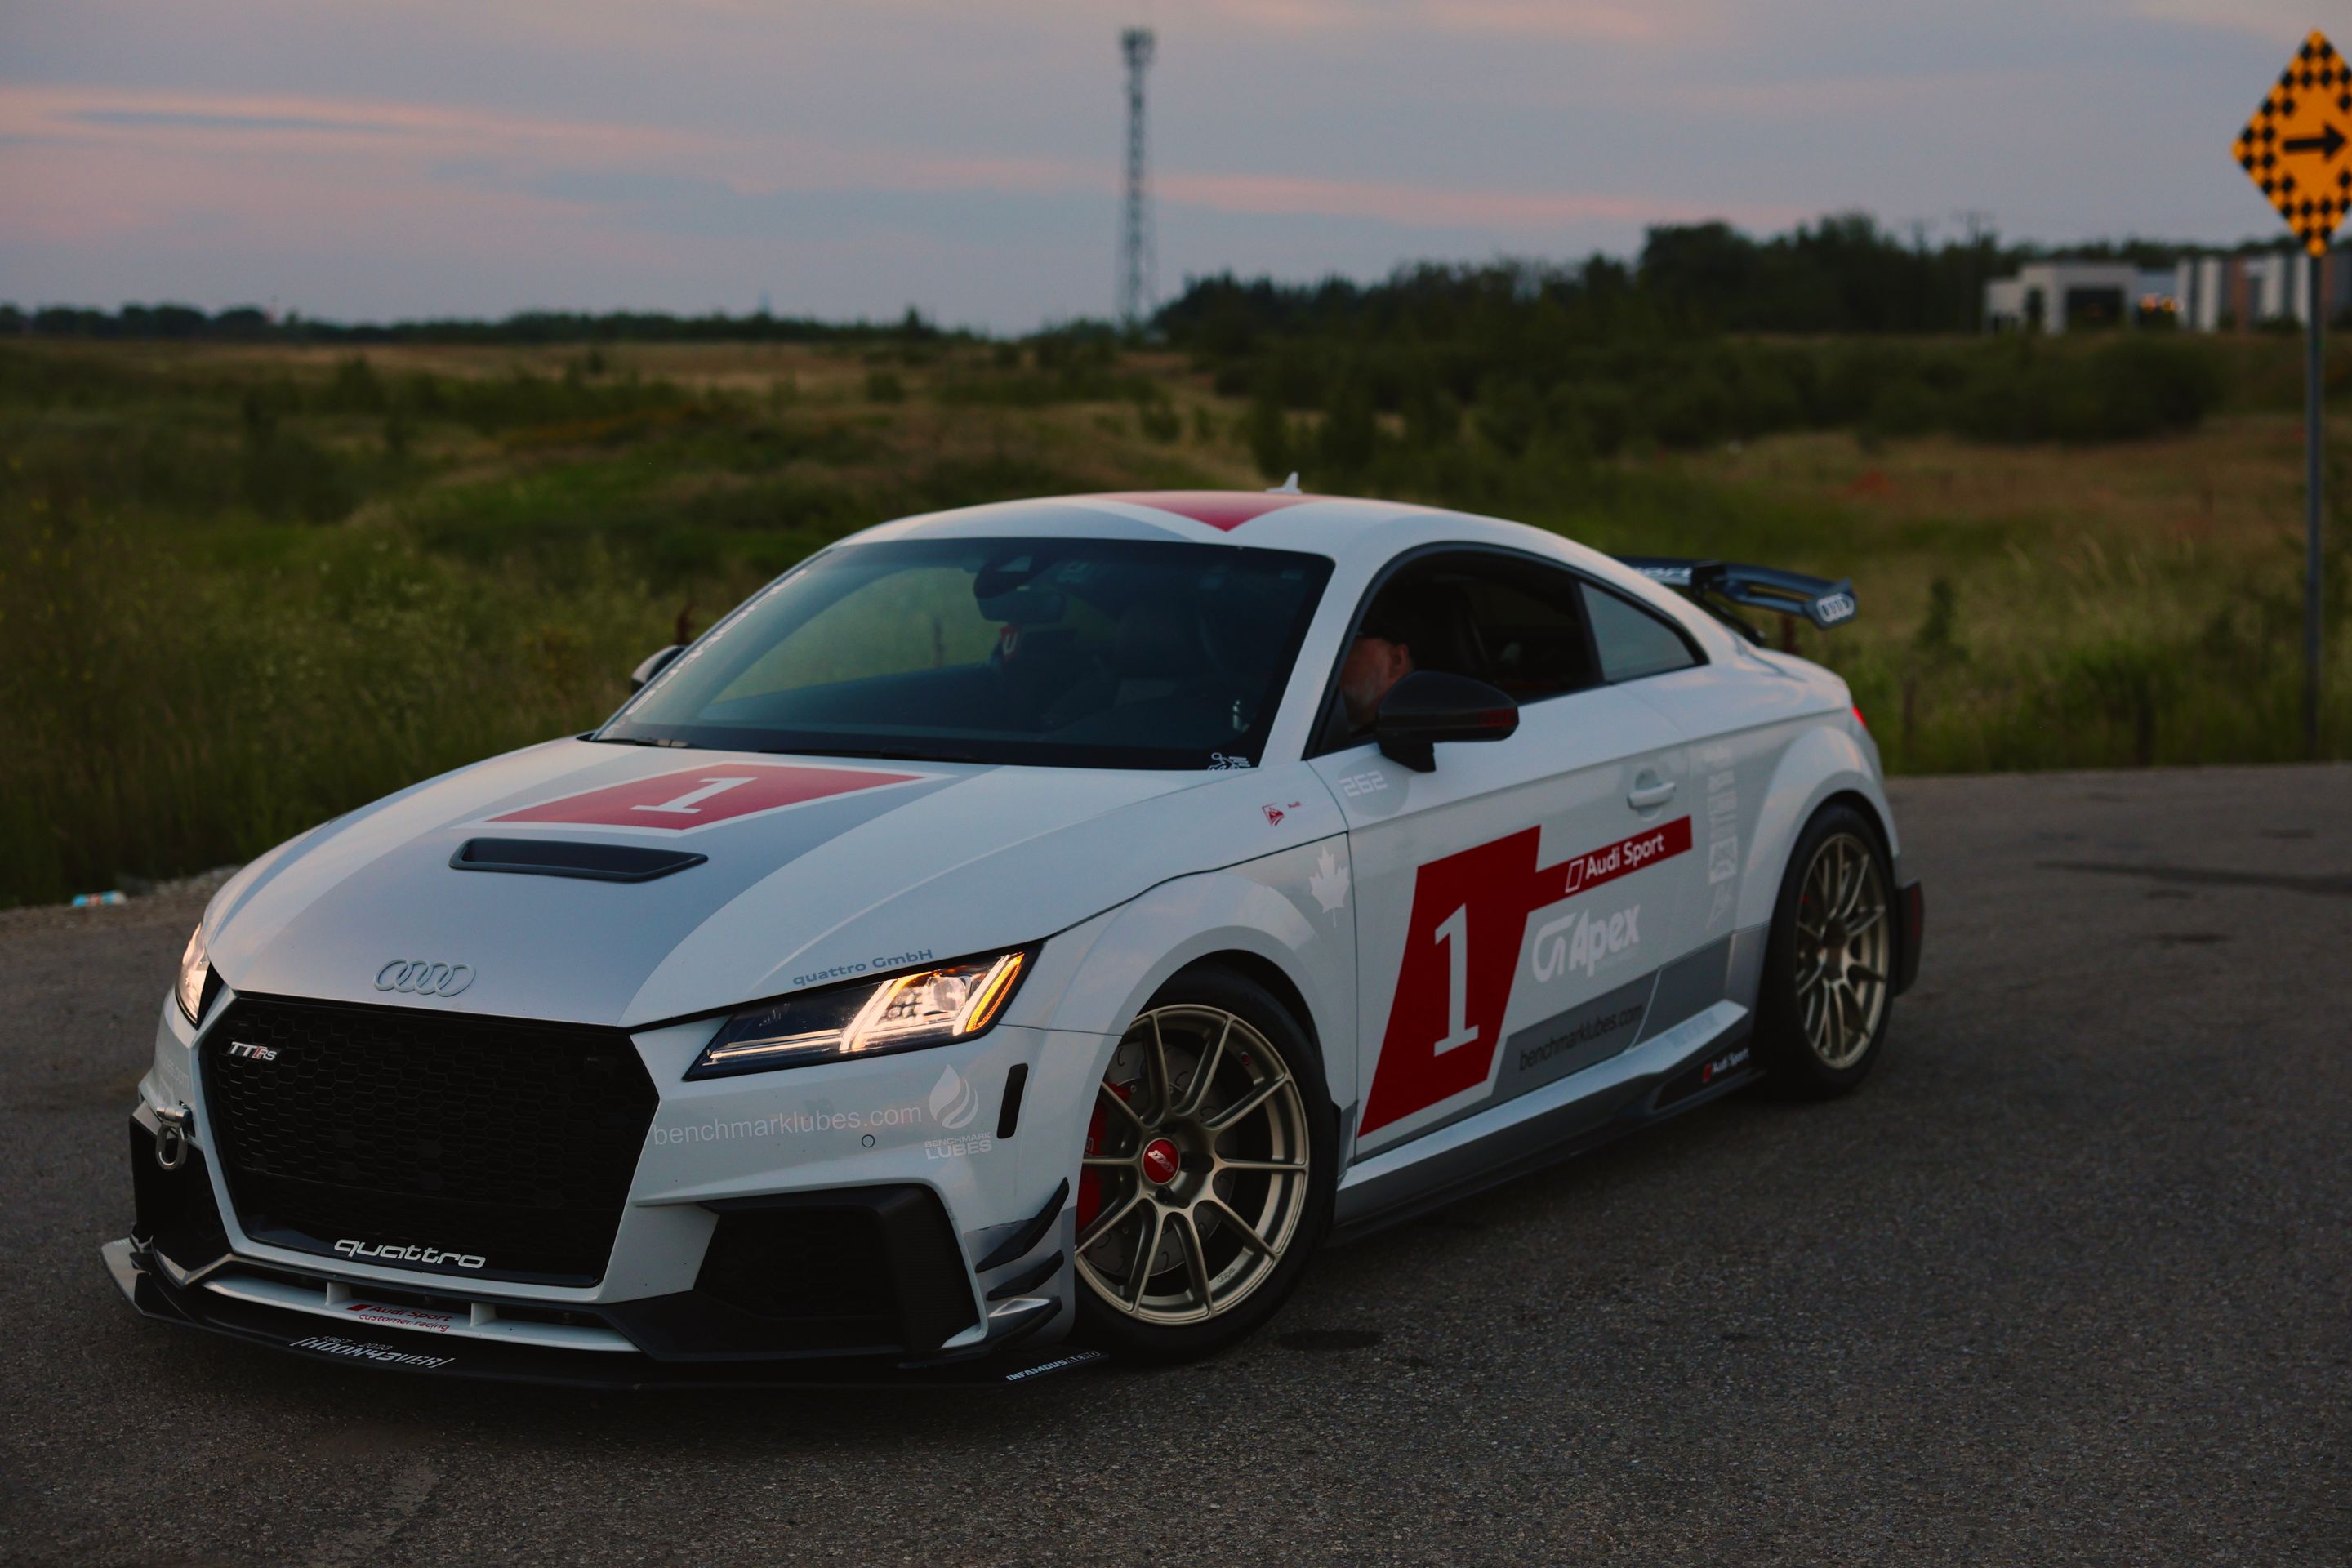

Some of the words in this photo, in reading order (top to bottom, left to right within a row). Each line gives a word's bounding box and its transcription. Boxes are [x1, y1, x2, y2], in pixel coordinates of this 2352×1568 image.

[630, 777, 758, 814] 1
[1339, 770, 1388, 798] 262
[1584, 847, 1621, 880] Audi
[1623, 831, 1665, 868] Sport
[793, 963, 867, 987] quattro
[872, 941, 933, 969] GmbH
[1433, 901, 1480, 1058] 1
[653, 1106, 922, 1146] benchmarklubes.com
[924, 1131, 991, 1148] BENCHMARK
[924, 1139, 993, 1160] LUBES
[333, 1238, 487, 1270] quattro
[359, 1313, 412, 1325] customer
[413, 1321, 450, 1333] racing
[368, 1306, 406, 1316] Audi
[407, 1309, 452, 1322] Sport
